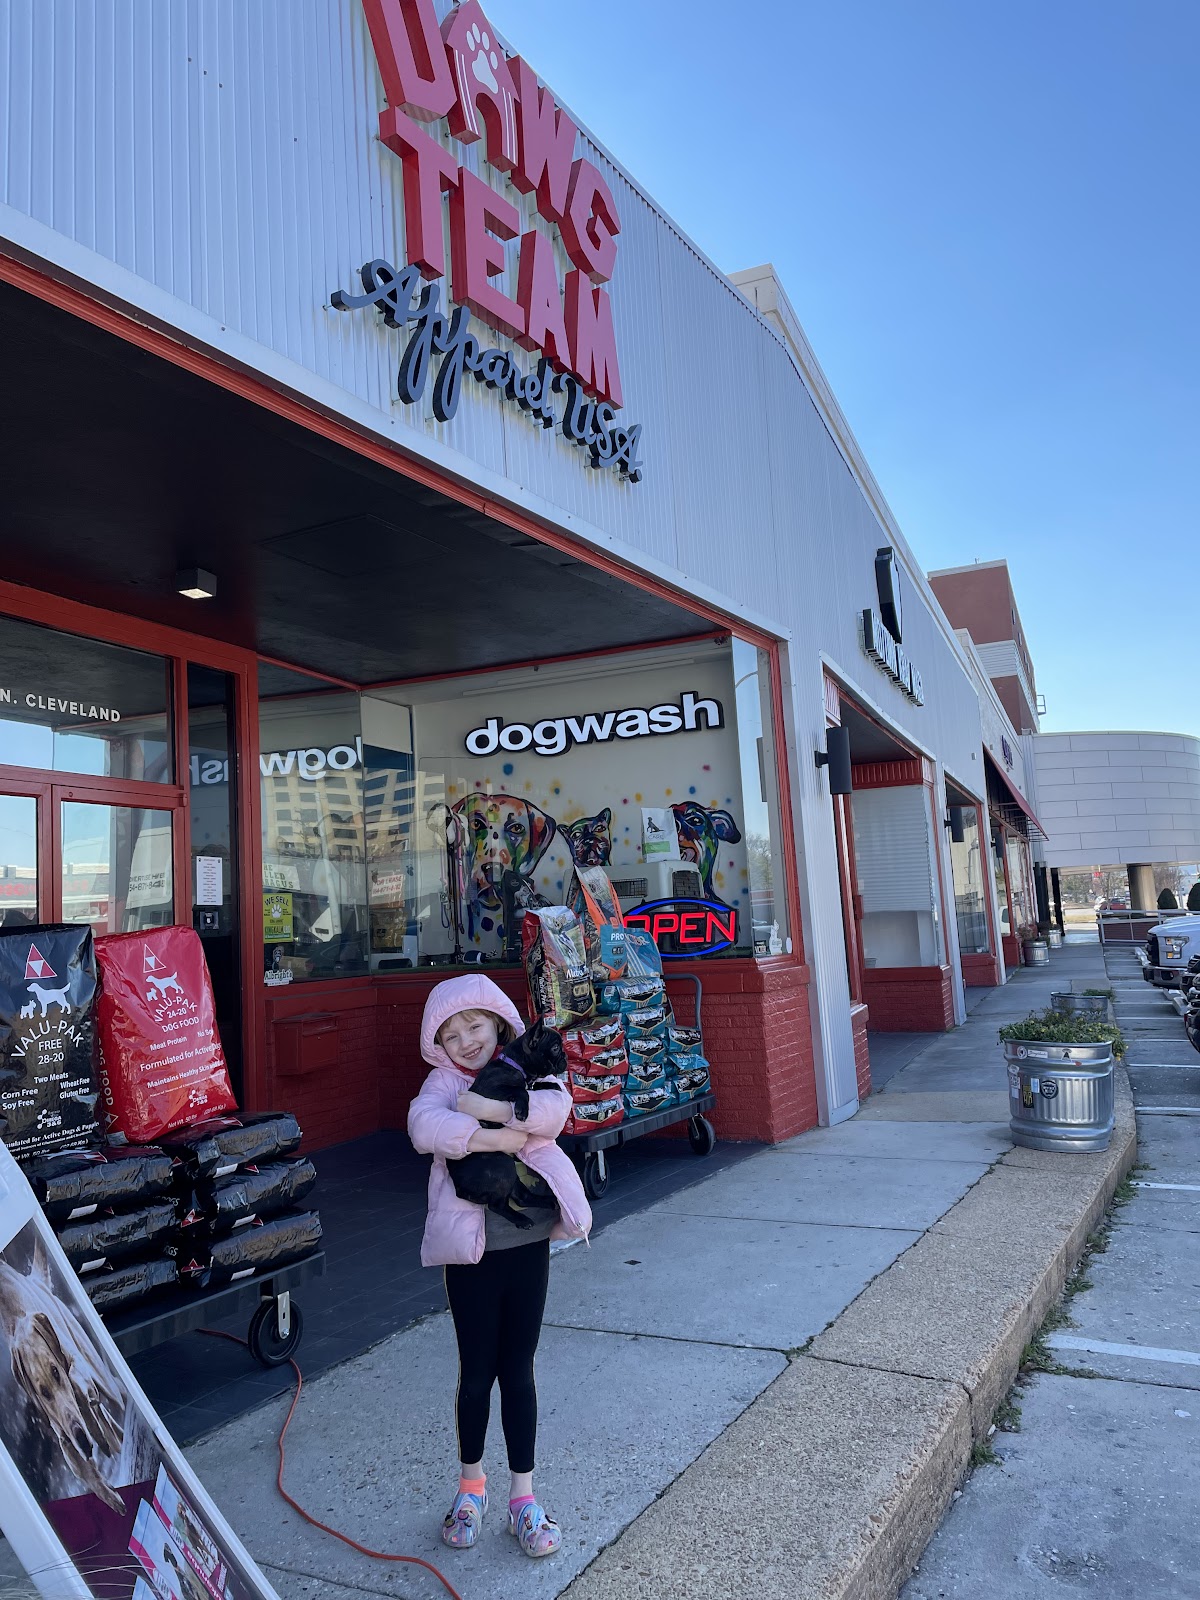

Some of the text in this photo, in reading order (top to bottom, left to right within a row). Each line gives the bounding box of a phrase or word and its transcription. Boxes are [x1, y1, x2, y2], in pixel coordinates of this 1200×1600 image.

[379, 106, 624, 410] TEAM
[25, 693, 121, 722] CLEVELAND
[465, 690, 725, 757] dogwash
[265, 895, 289, 907] WE SELL
[154, 996, 198, 1022] VALU-PAK
[166, 1007, 187, 1019] 24-20
[161, 1016, 200, 1033] DOG FOOD
[10, 1019, 84, 1057] VALU-PAK
[149, 1035, 188, 1052] Meat Protein
[38, 1039, 62, 1051] FREE
[37, 1052, 64, 1065] 28-20
[140, 1052, 185, 1072] Formulated
[185, 1049, 194, 1059] for
[34, 1071, 69, 1084] Two Meats
[60, 1077, 91, 1089] Wheat Free
[147, 1074, 179, 1088] Maintains
[179, 1067, 199, 1079] Healthy
[1, 1087, 39, 1100] Corn Free
[59, 1087, 90, 1099] Gluten Free
[2, 1099, 35, 1111] Soy Free
[42, 1131, 61, 1140] Active
[61, 1128, 76, 1137] Dogs
